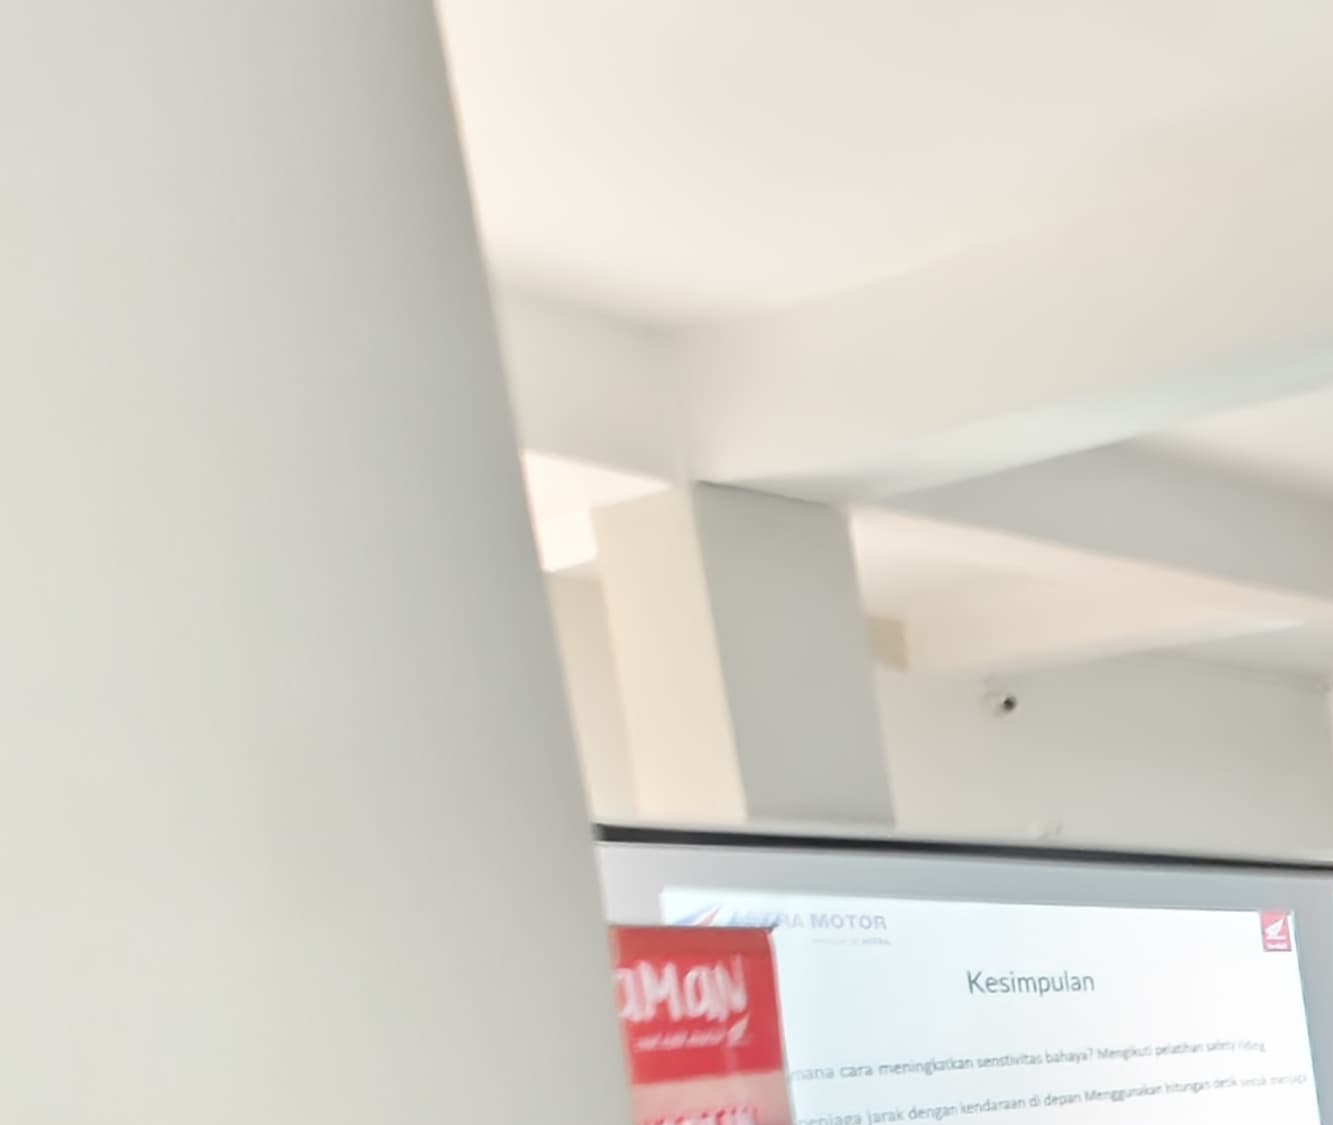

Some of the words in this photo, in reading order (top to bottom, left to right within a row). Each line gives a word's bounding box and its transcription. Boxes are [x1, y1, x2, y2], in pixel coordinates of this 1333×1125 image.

[810, 913, 888, 930] MOTOR
[967, 970, 1095, 997] Kesimpulan
[839, 1064, 874, 1078] cara
[878, 1055, 974, 1076] meningkatkan
[1046, 1049, 1093, 1066] bahaya?
[908, 1103, 957, 1122] dengan
[960, 1097, 1025, 1115] kendaraan
[1029, 1094, 1041, 1108] di
[1044, 1090, 1082, 1107] depan
[1084, 1082, 1163, 1103] Menggunakan
